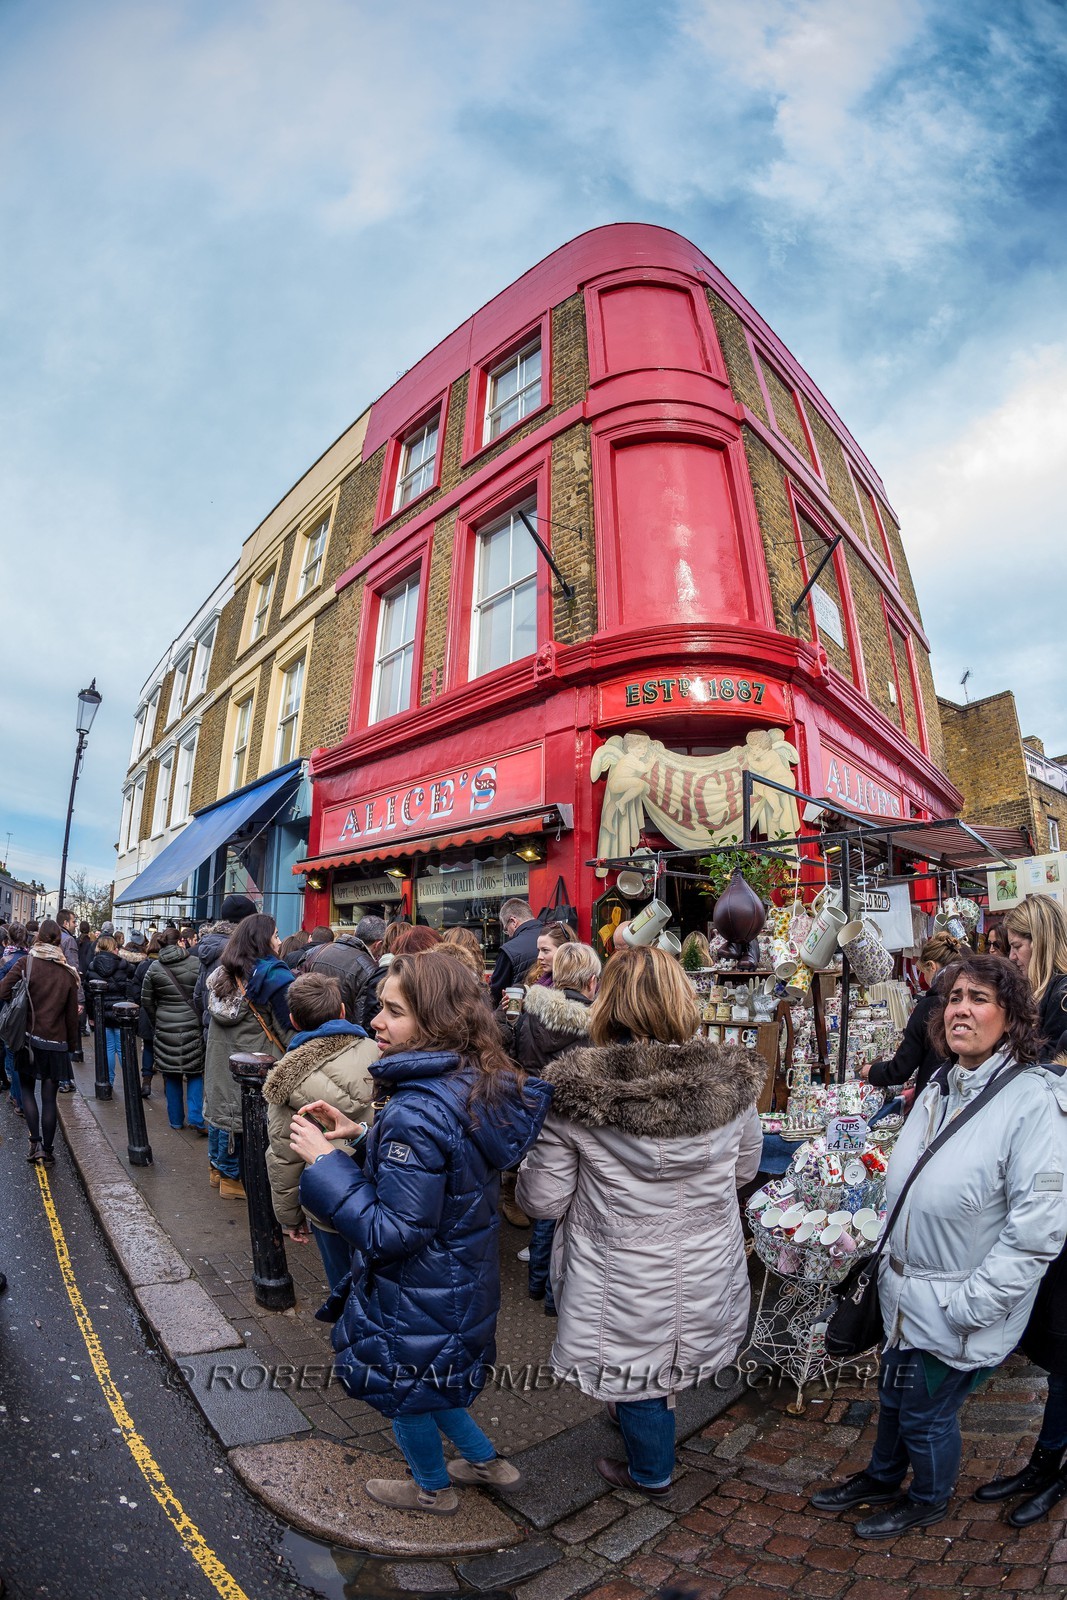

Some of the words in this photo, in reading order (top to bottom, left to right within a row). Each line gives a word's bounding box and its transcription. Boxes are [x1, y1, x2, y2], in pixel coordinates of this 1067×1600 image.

[709, 678, 766, 704] 1887
[338, 763, 498, 842] ALICE'S
[353, 884, 372, 899] QUEEN
[451, 879, 475, 896] QUALITY
[476, 876, 497, 891] GOODS
[503, 871, 528, 888] EMPIRE
[835, 1122, 860, 1131] CUPS
[827, 1140, 841, 1150] £4
[843, 1141, 865, 1149] Each
